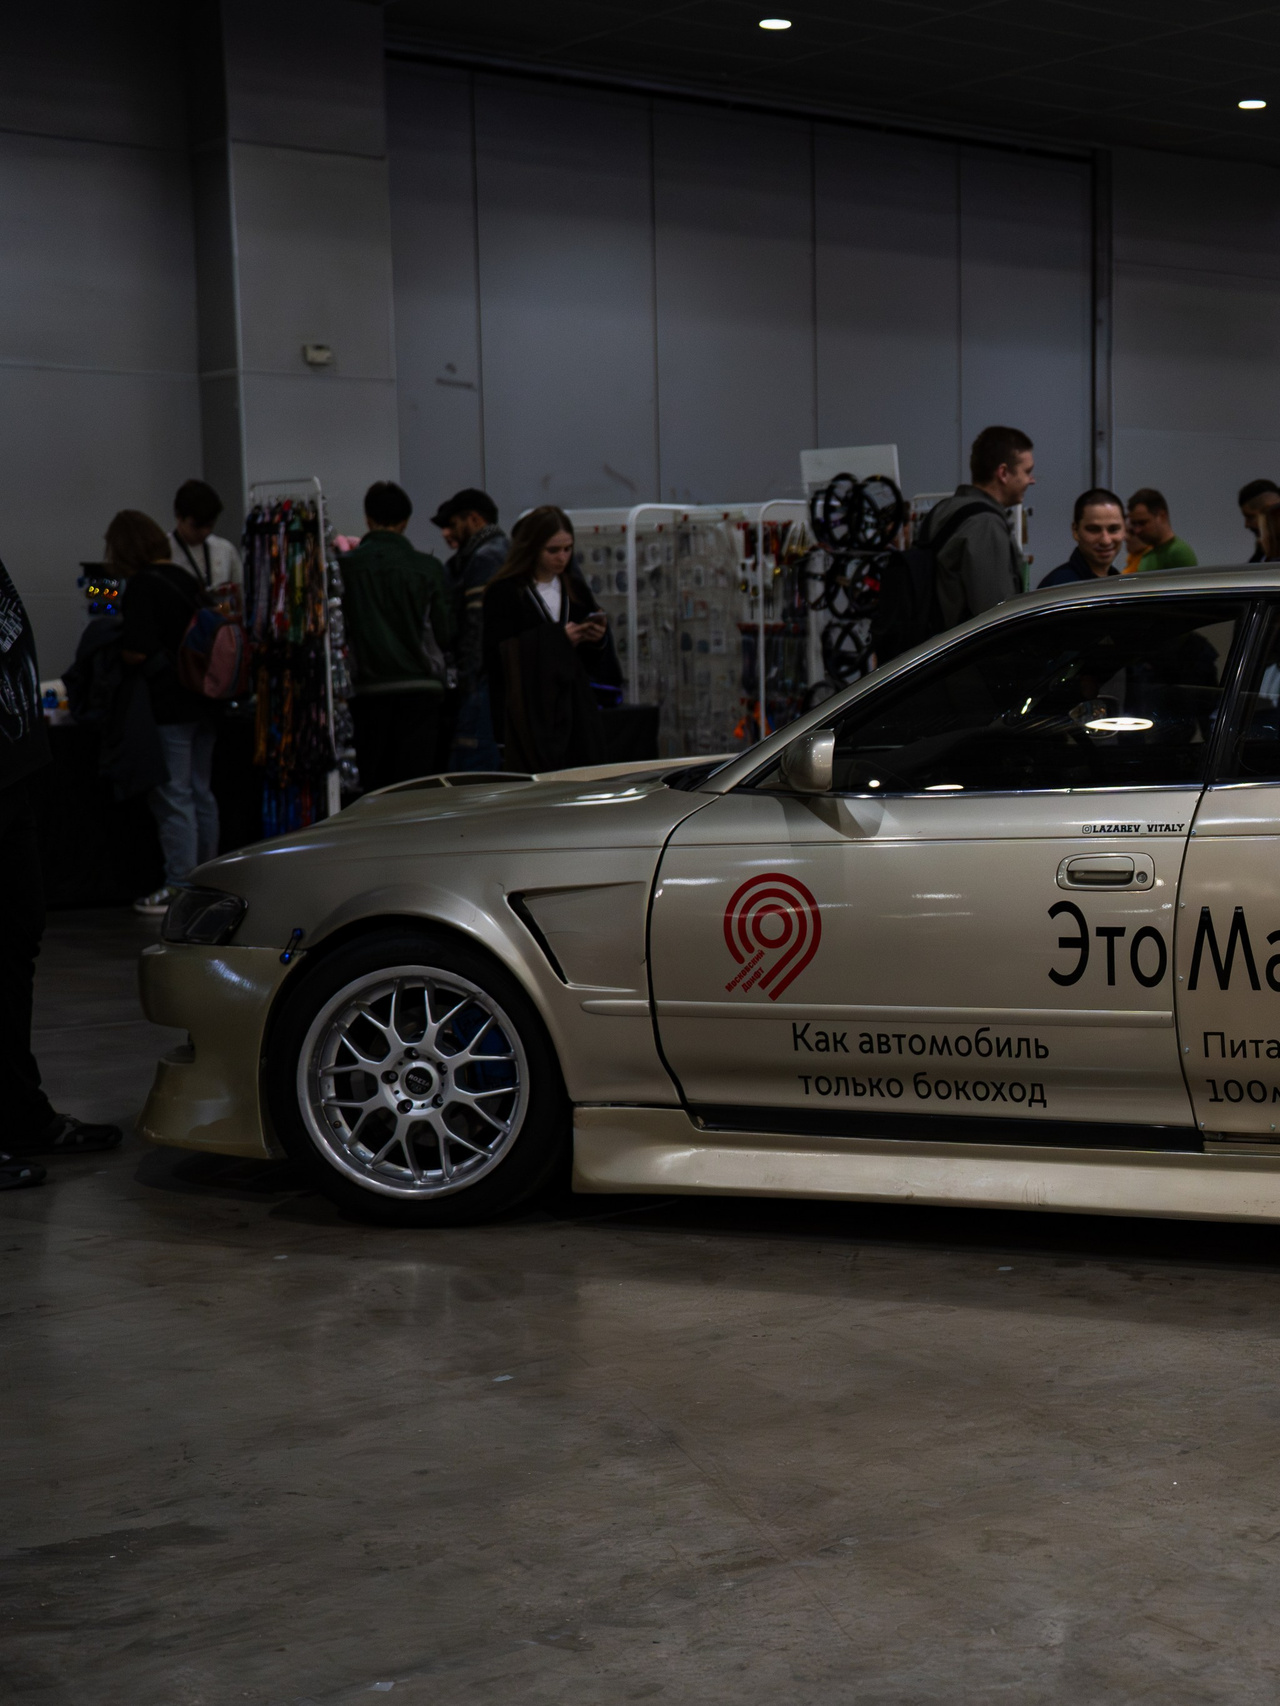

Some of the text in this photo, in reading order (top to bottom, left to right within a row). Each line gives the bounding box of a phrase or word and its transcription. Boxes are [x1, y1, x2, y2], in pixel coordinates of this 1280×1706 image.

[1047, 900, 1168, 987] Это
[791, 1022, 1050, 1060] Как автомобиль
[798, 1071, 1048, 1109] только бокоход
